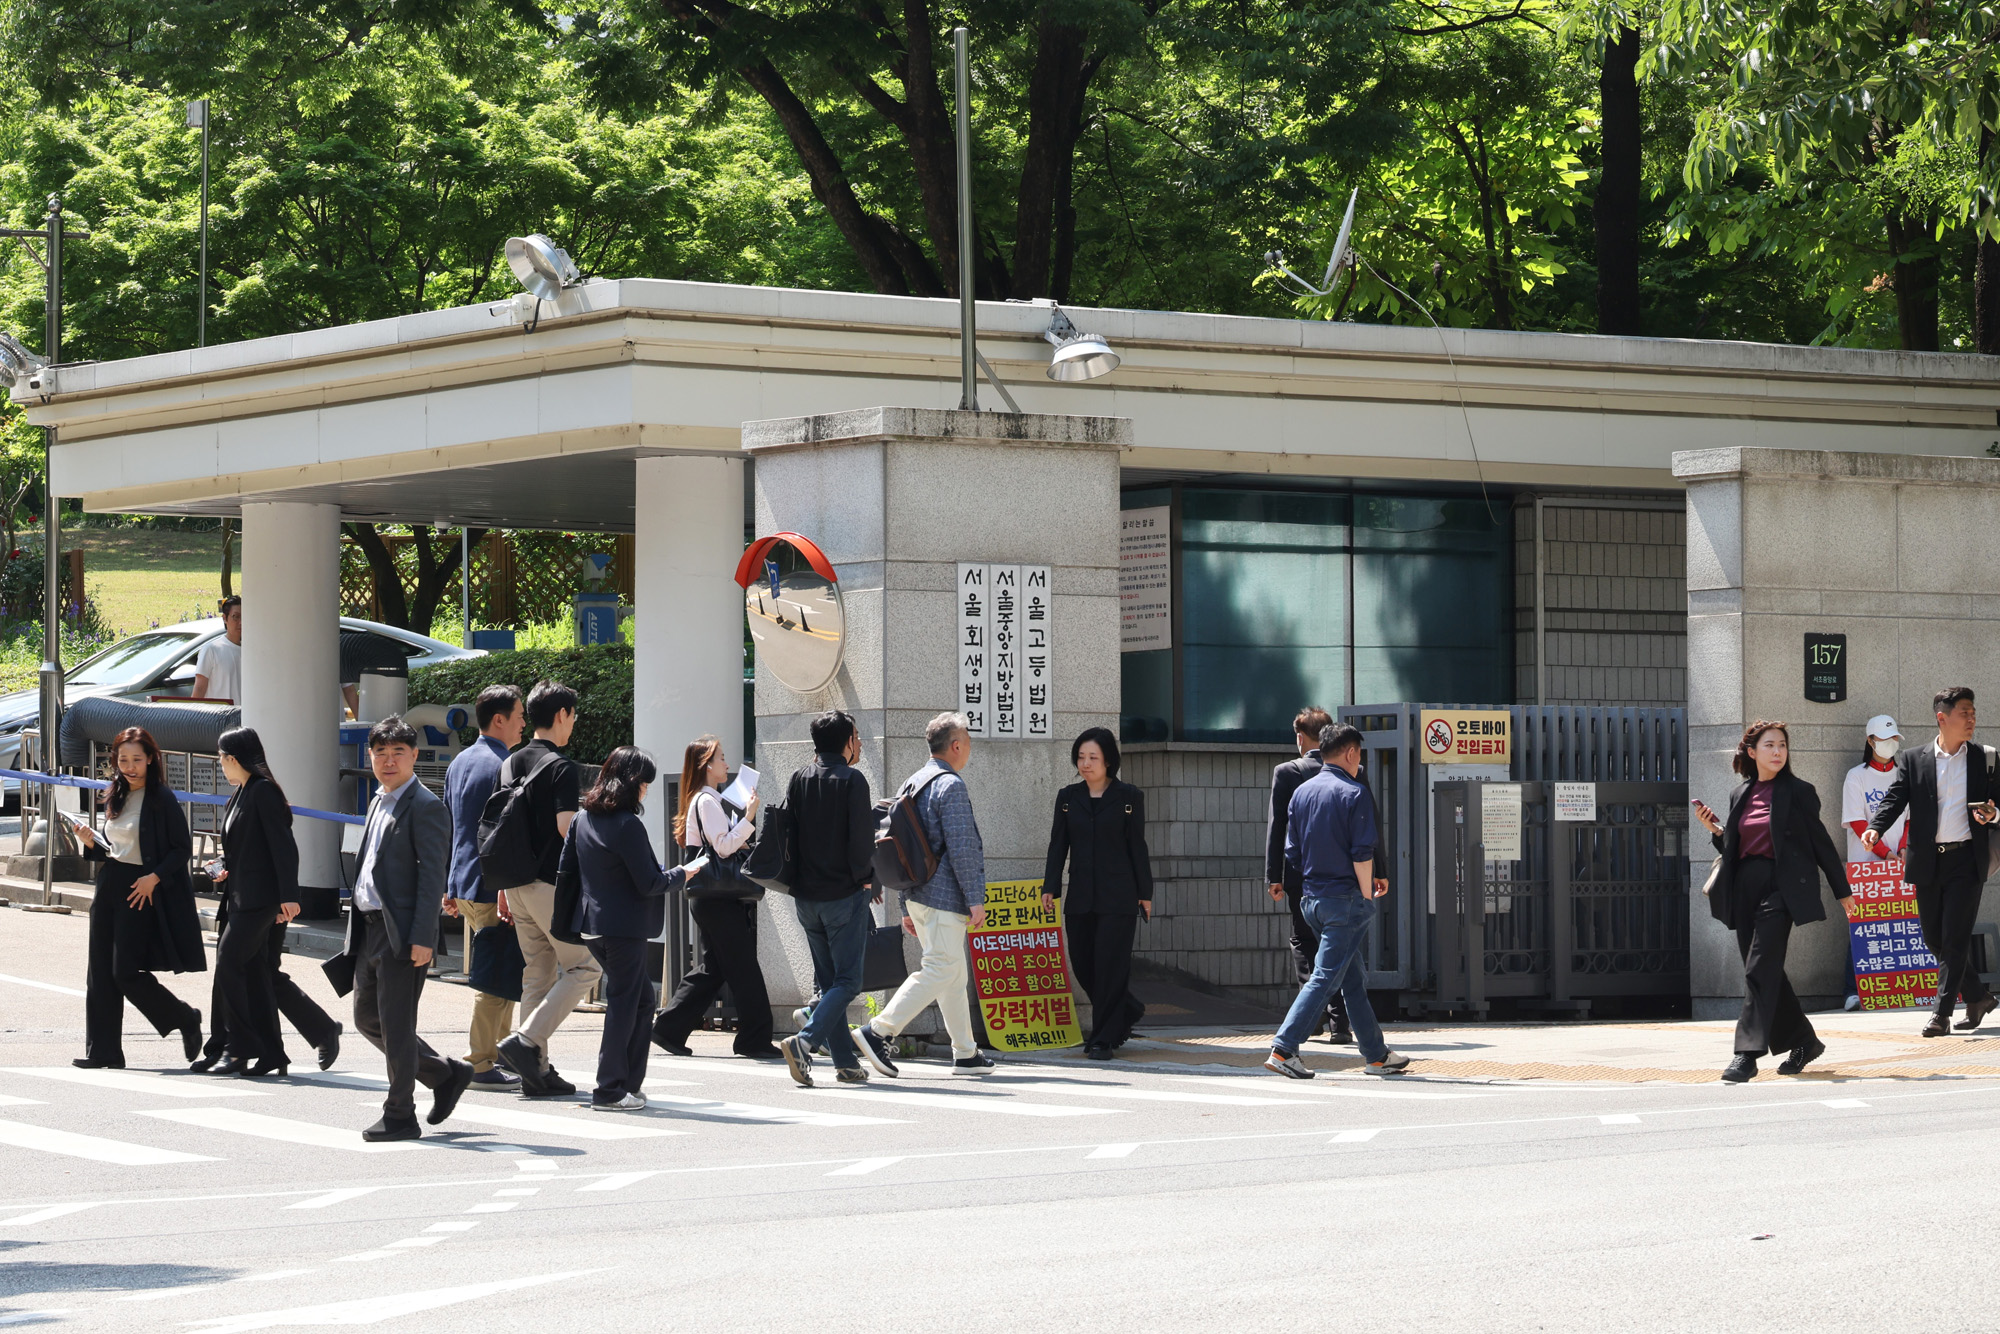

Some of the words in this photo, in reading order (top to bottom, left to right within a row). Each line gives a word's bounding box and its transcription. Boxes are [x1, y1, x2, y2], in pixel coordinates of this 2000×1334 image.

[965, 568, 982, 732] 서울회생법원
[996, 570, 1014, 733] 서울중앙지방법원
[1028, 570, 1046, 734] 서울고등법원
[1810, 644, 1842, 665] 157
[1457, 720, 1505, 735] 오토바이
[1457, 740, 1505, 754] 진입금지
[1865, 788, 1888, 803] KO
[1852, 860, 1905, 878] 25고단
[1850, 880, 1895, 899] 박강균
[1899, 880, 1916, 896] 판
[984, 906, 1011, 927] 강균
[1016, 906, 1056, 925] 판사님
[1852, 899, 1918, 919] 아도인터네
[1855, 922, 1890, 937] 4년째
[1893, 921, 1922, 935] 피눈
[973, 931, 1059, 952] 아도인터네셔널
[1867, 939, 1906, 954] 흘리고
[1856, 956, 1895, 971] 수많은
[1859, 976, 1890, 993] 아도
[1894, 972, 1938, 990] 사기꾼
[1862, 993, 1916, 1010] 강력처벌
[986, 997, 1072, 1030] 강력처벌
[1005, 1030, 1067, 1048] 해주세요!!!
